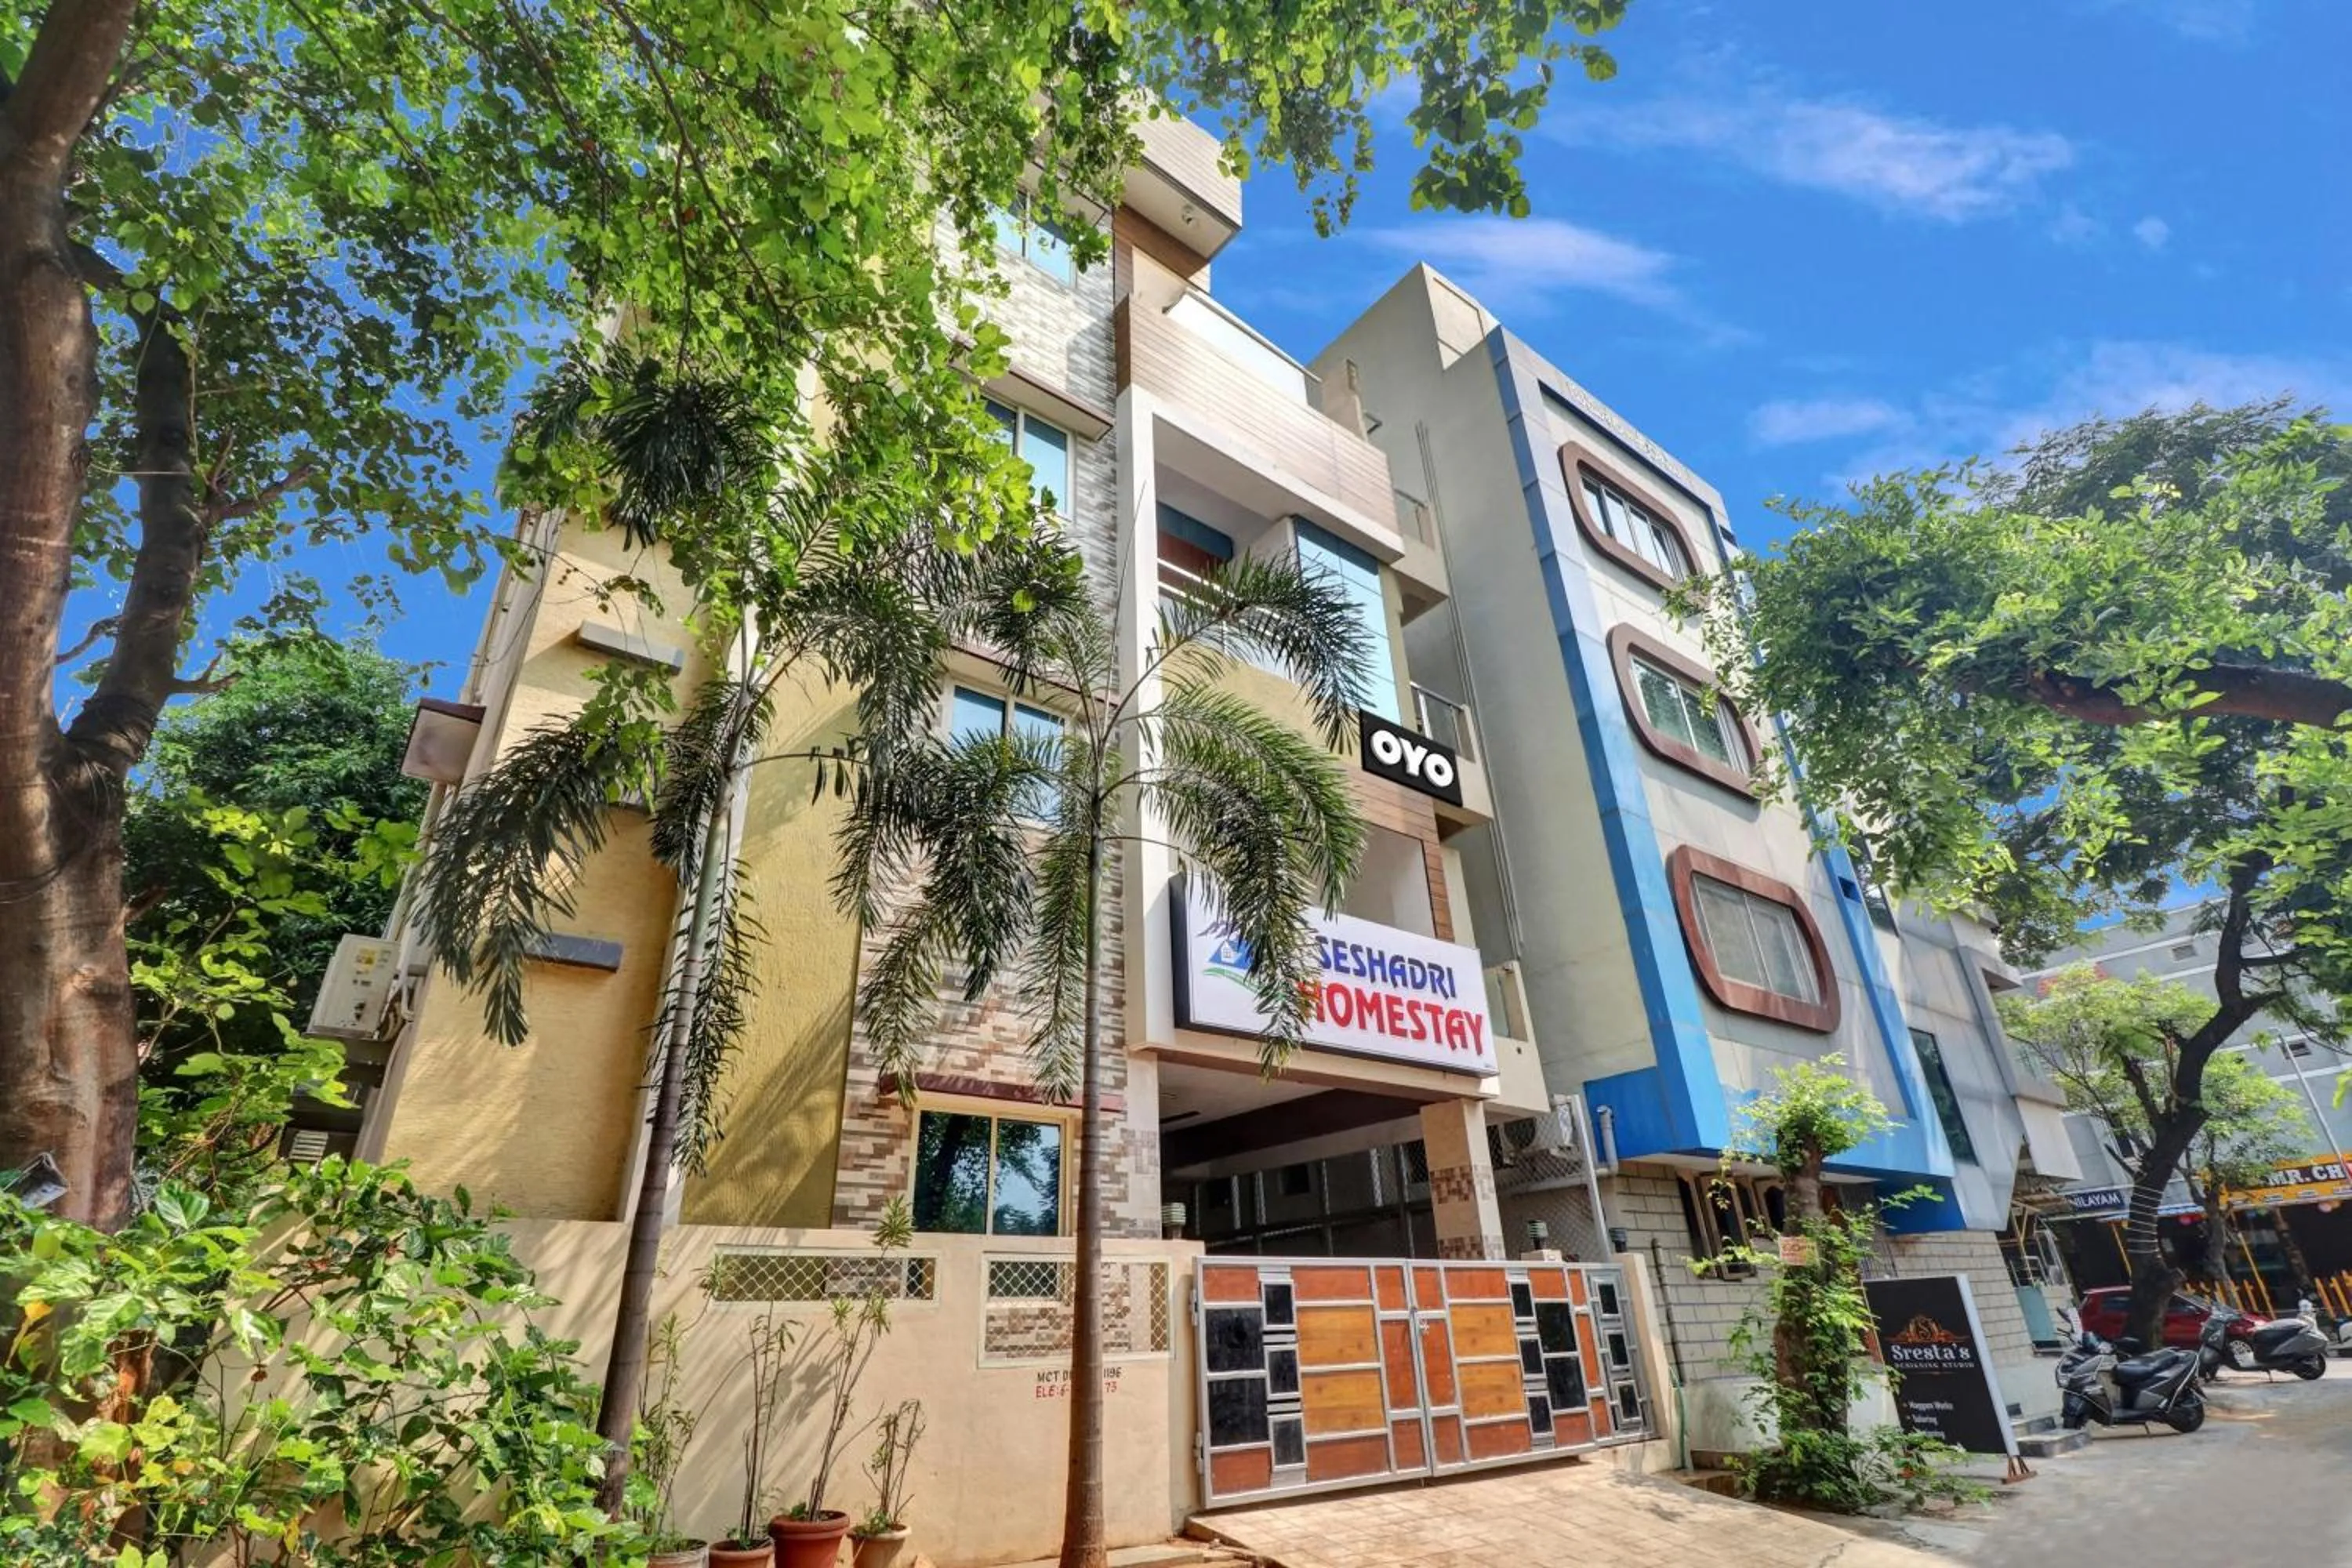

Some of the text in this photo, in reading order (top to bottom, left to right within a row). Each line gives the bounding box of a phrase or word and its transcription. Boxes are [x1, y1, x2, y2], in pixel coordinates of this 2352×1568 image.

[1370, 730, 1454, 787] OYO
[1315, 935, 1457, 1000] SESHADRI
[1891, 1343, 1971, 1361] Sresta's
[1037, 1370, 1060, 1382] MCT
